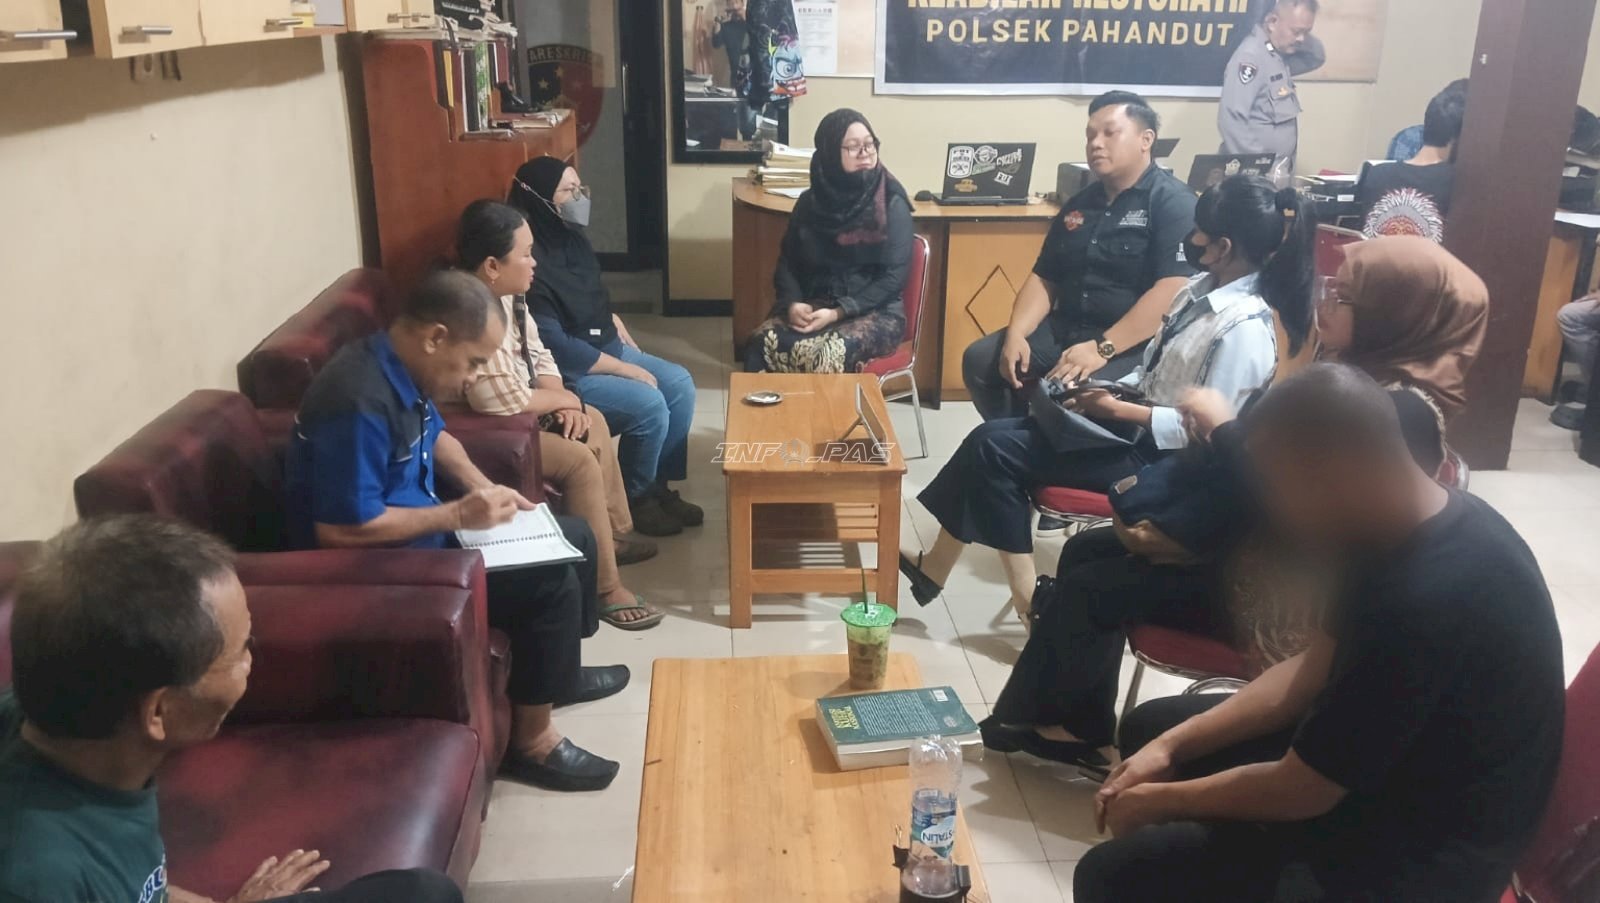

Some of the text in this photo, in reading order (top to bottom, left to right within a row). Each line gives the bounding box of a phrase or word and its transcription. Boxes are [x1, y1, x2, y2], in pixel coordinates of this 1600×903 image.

[926, 19, 1234, 47] POLSEK PAHANDUT
[529, 47, 592, 61] ARESKRI
[922, 829, 954, 844] STALIN
